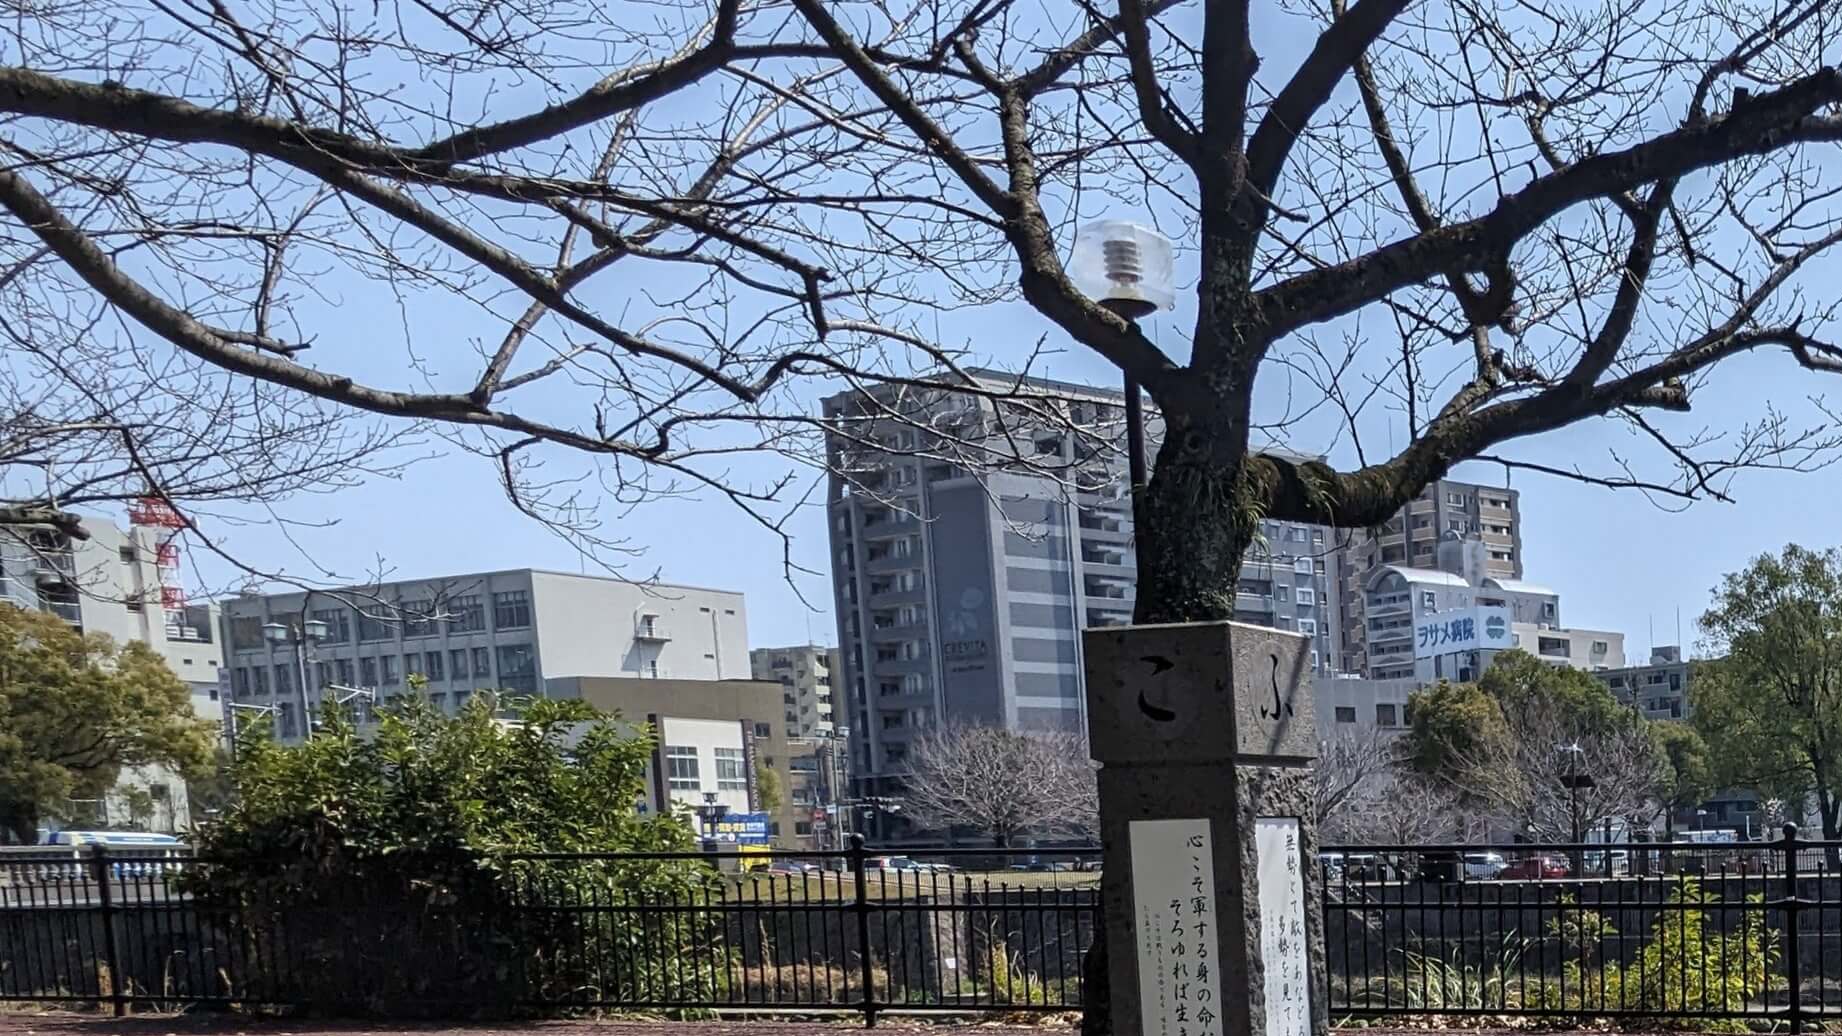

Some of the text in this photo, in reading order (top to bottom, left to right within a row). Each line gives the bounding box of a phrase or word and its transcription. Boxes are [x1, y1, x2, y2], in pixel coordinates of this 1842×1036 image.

[1418, 617, 1475, 648] ヲサメ病院
[1137, 655, 1176, 722] こ
[1260, 654, 1294, 722] ふ
